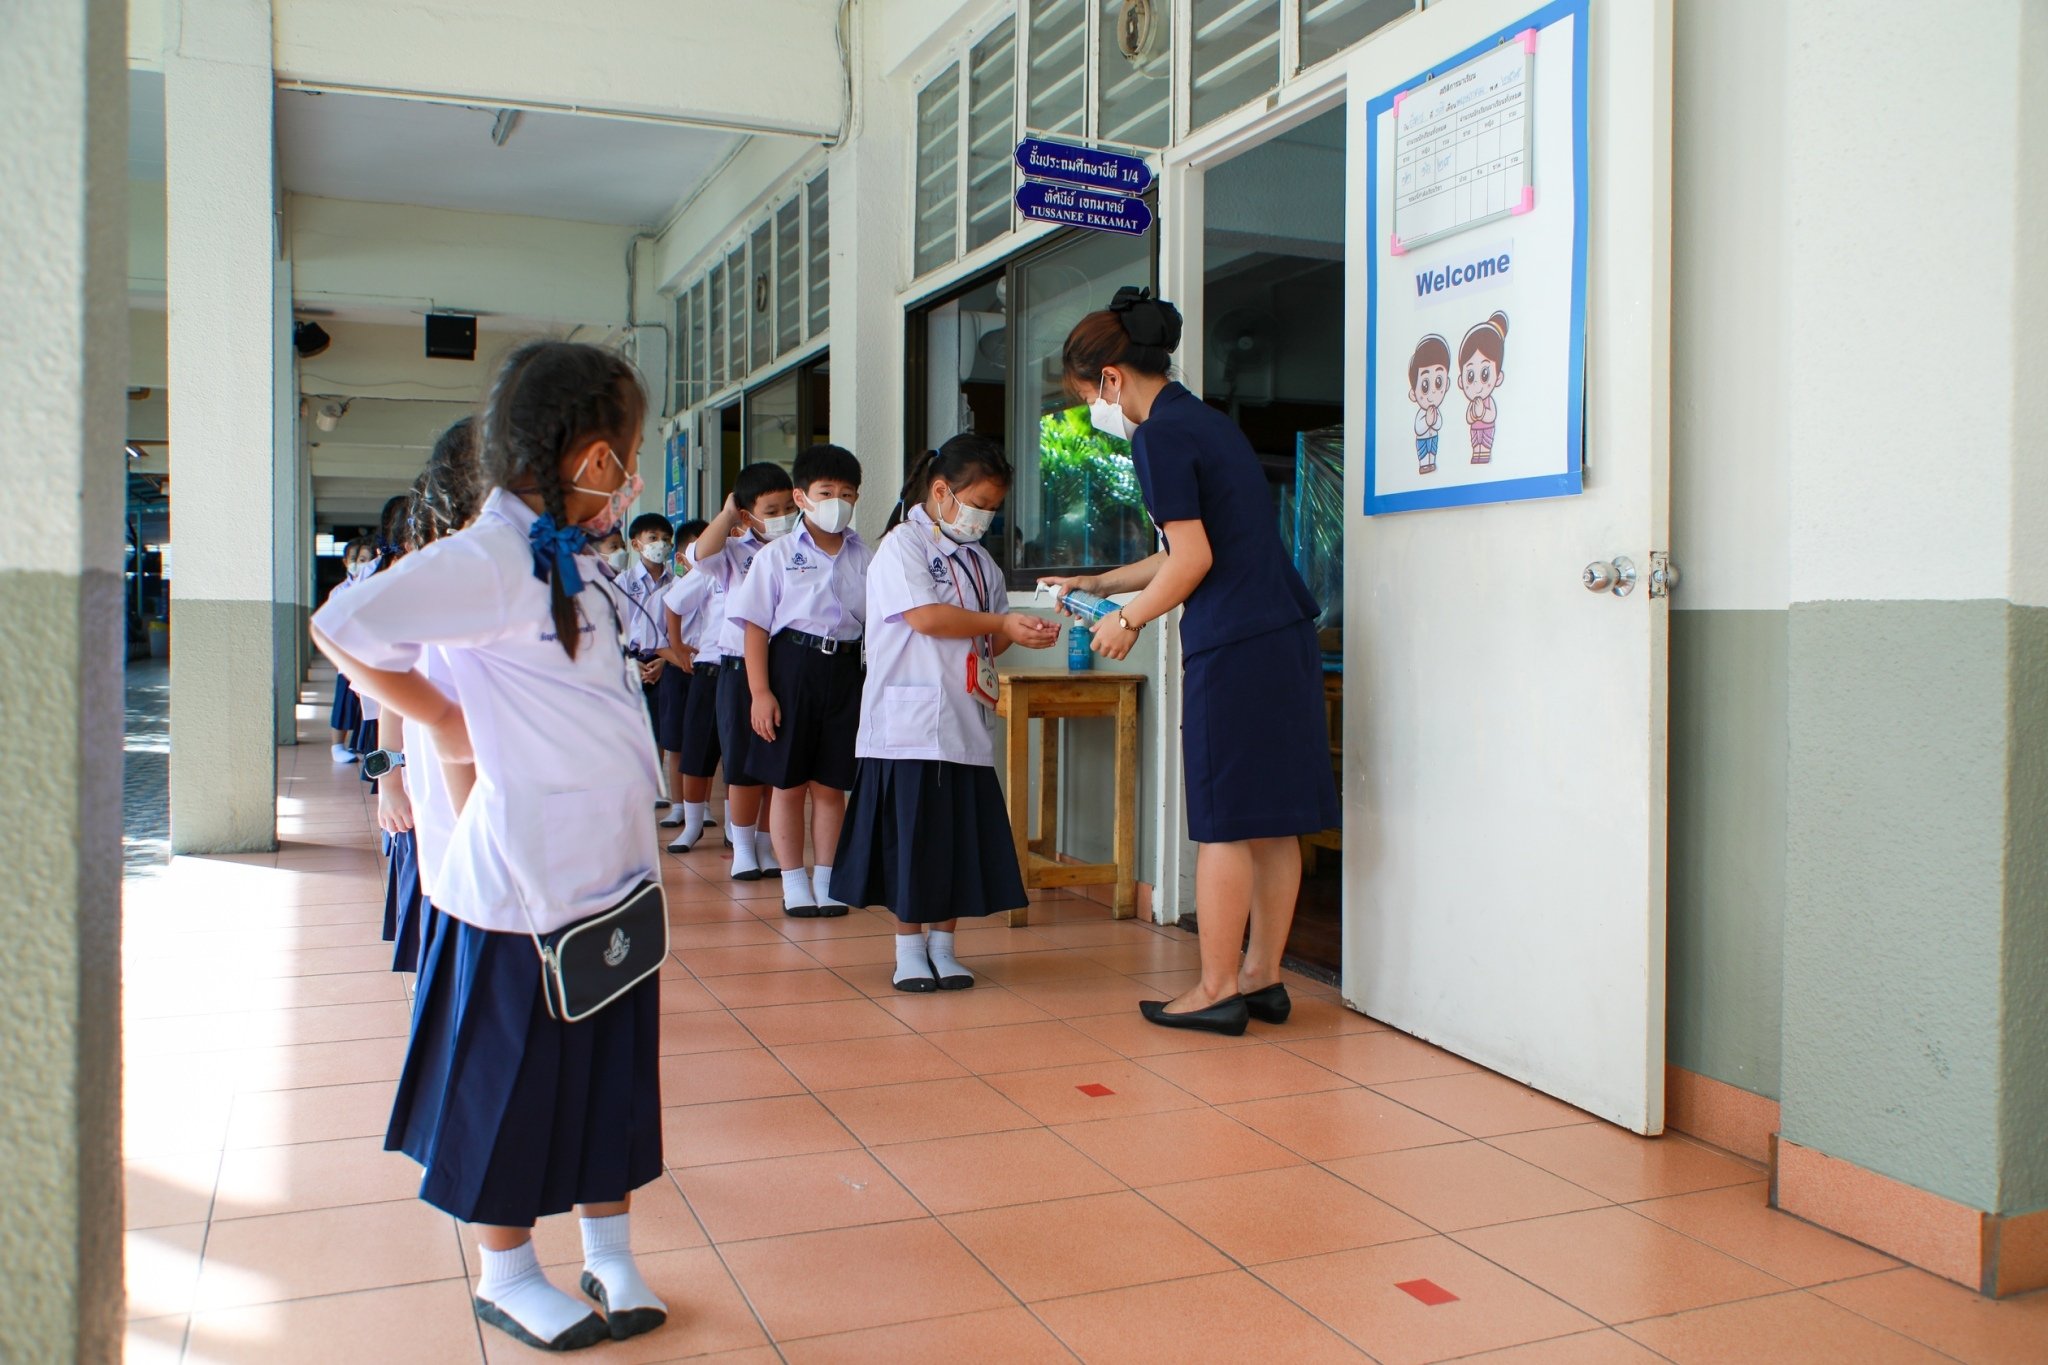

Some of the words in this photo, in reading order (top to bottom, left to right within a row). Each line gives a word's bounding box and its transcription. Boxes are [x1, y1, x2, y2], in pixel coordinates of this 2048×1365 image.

[1029, 145, 1118, 179] ชั้นประถมศึกษาปีที่
[1122, 169, 1139, 184] 1/4
[1030, 205, 1085, 223] TUSSANEE
[1087, 213, 1139, 230] EKKAMAT
[1415, 252, 1511, 298] Welcome
